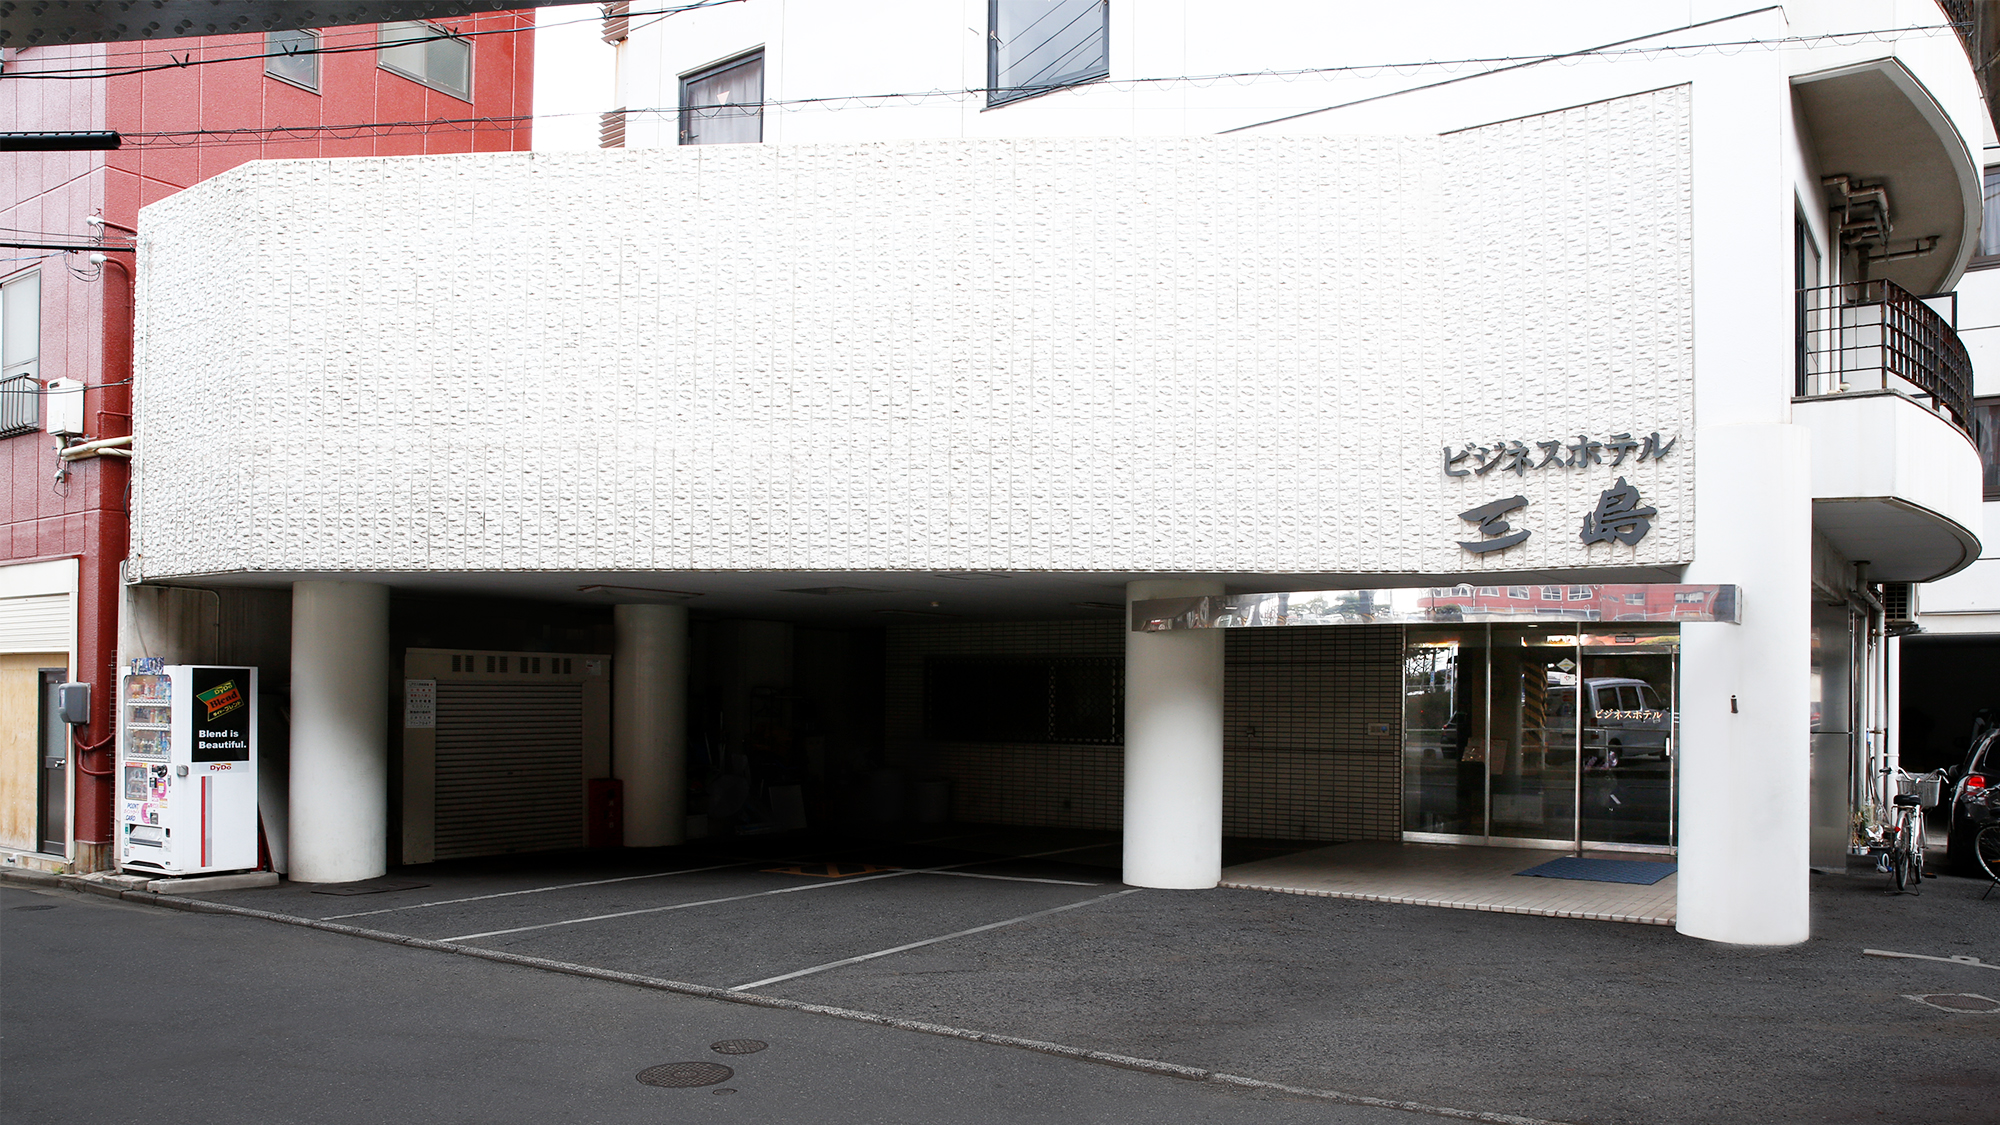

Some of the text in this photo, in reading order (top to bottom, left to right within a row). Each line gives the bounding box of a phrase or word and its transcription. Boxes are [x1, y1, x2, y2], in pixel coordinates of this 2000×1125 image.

[1443, 432, 1677, 477] ビジネスホテル
[1456, 476, 1658, 553] 三島
[209, 691, 238, 709] Blend
[1594, 709, 1663, 721] ビジネスホテル
[198, 730, 240, 738] Blend is
[198, 741, 247, 749] Beautiful.
[210, 763, 232, 772] DyDo
